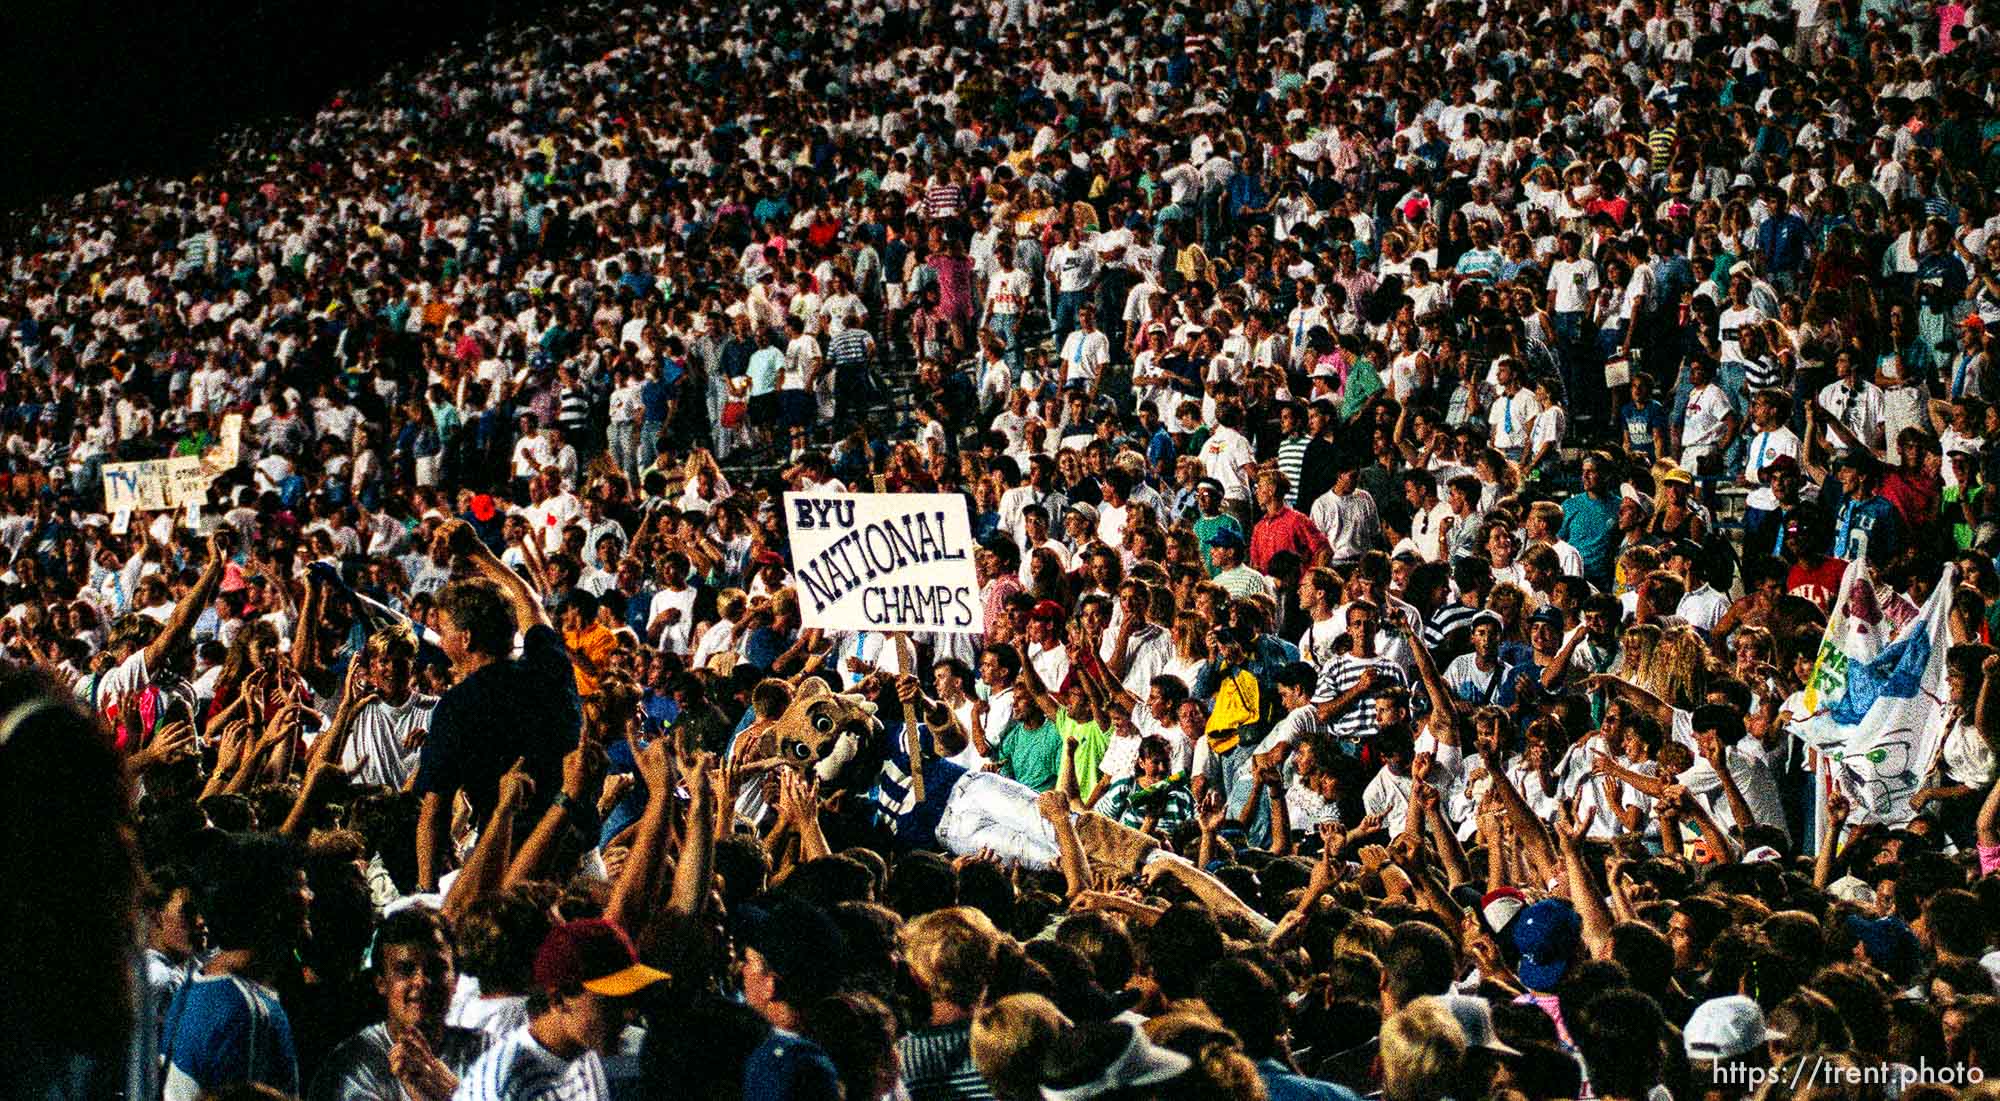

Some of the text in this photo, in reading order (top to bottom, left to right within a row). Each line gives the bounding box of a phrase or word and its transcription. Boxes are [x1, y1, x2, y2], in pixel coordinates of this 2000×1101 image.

[106, 469, 137, 498] TV
[793, 498, 855, 528] BYU
[797, 511, 967, 613] NATIONAL
[863, 585, 973, 626] CHAMPS
